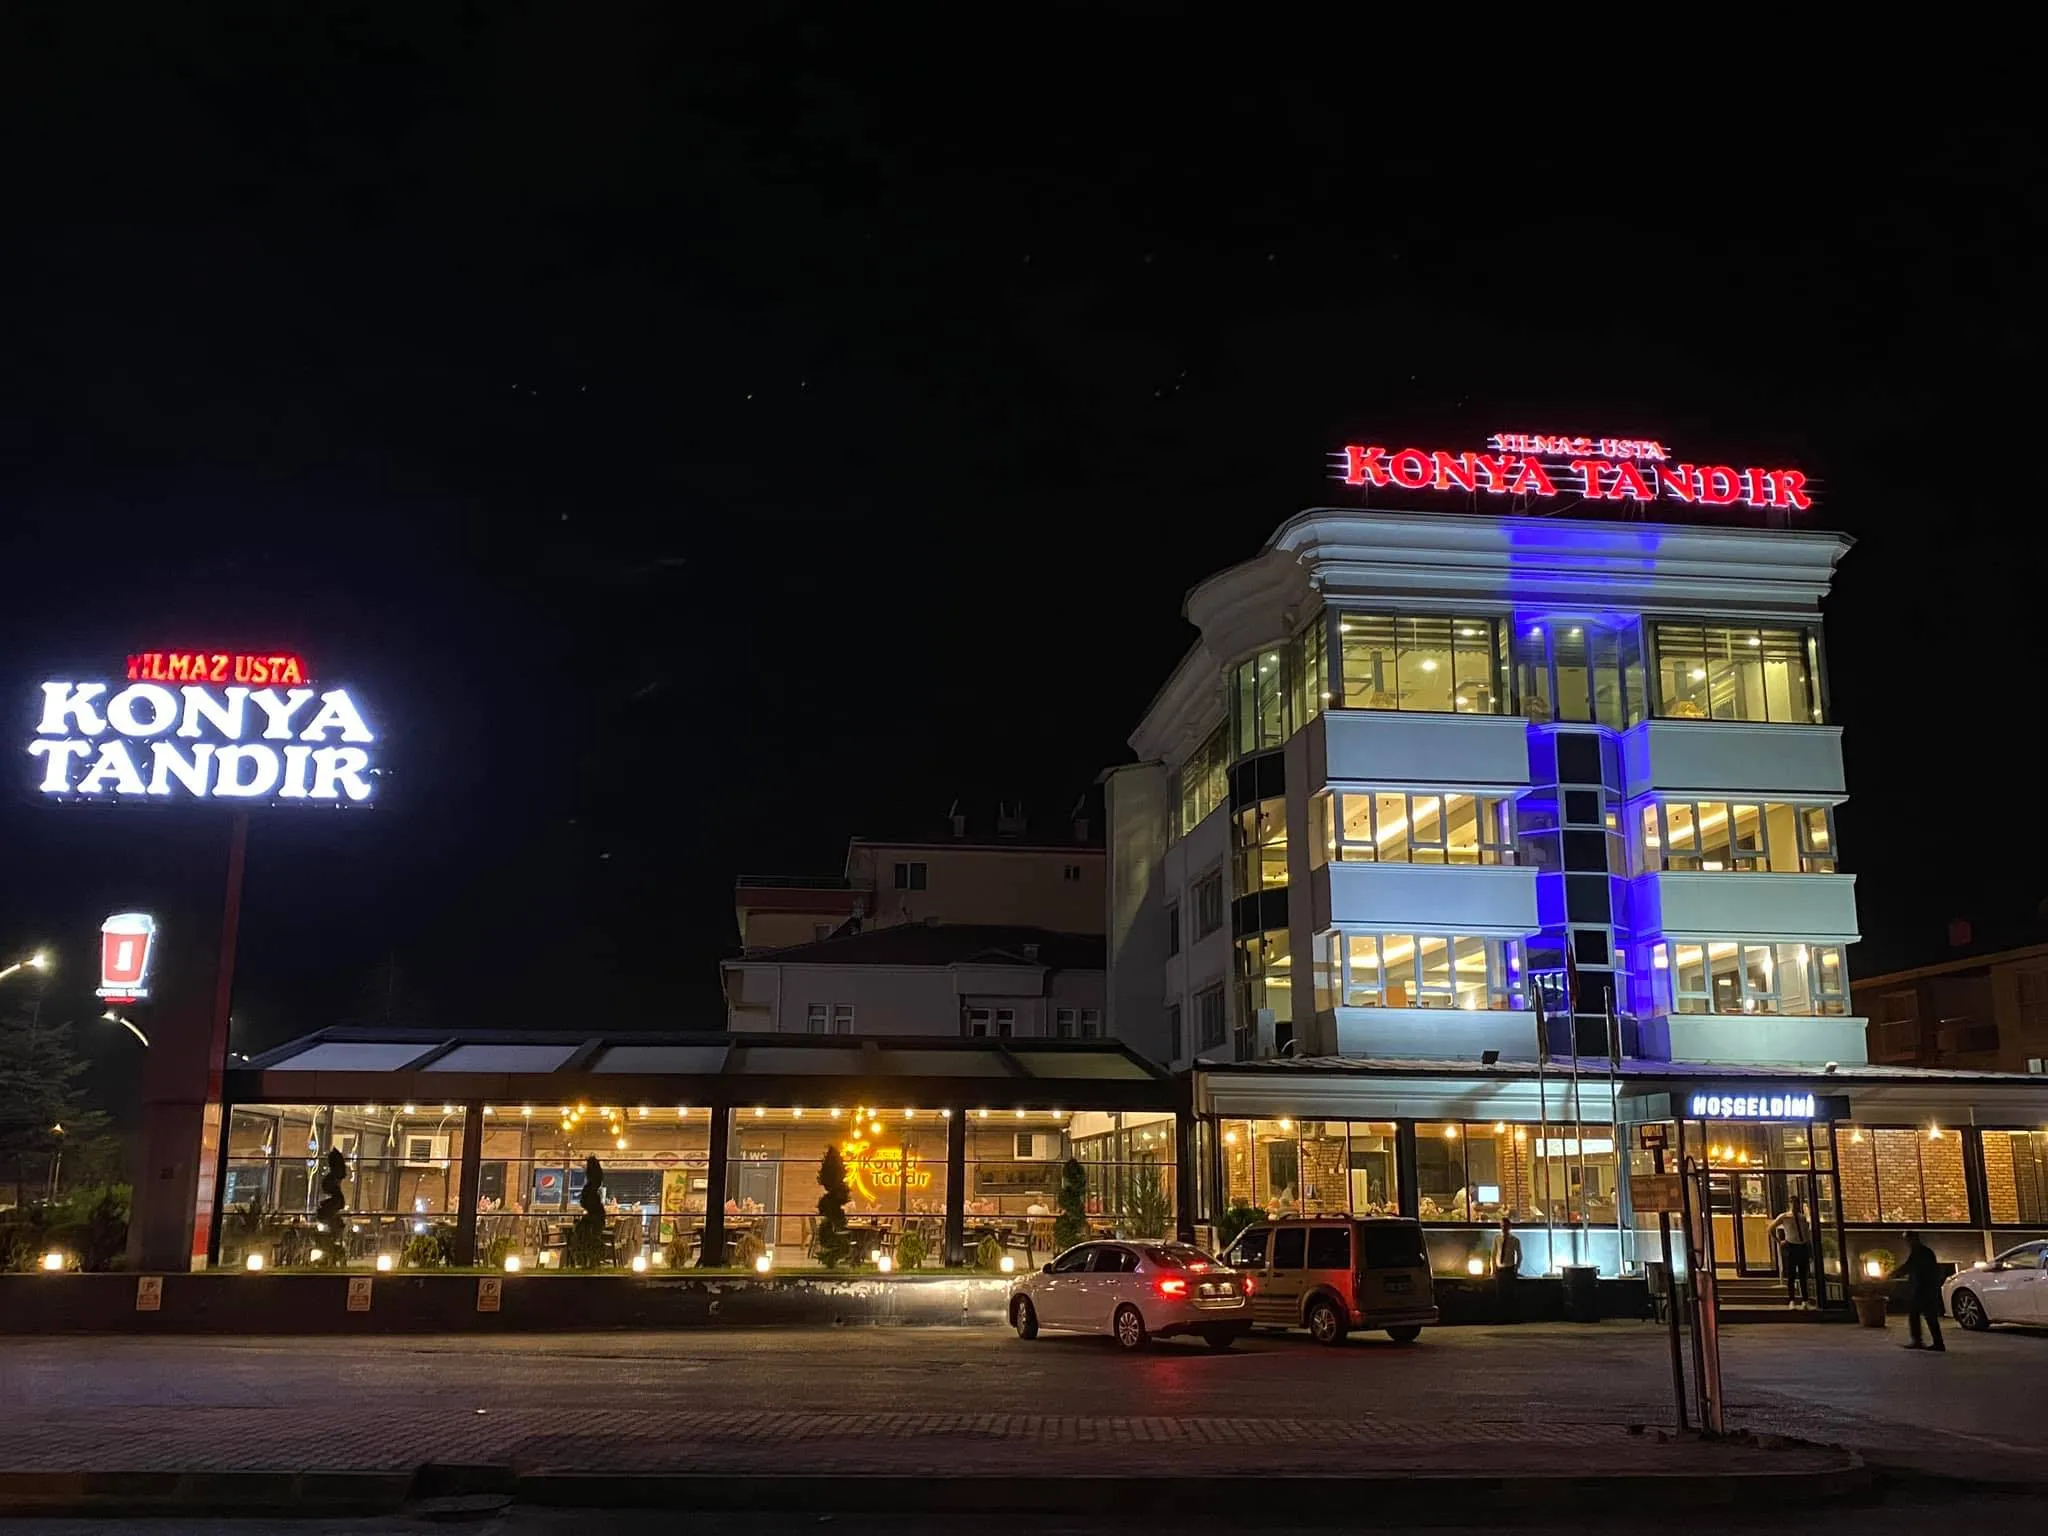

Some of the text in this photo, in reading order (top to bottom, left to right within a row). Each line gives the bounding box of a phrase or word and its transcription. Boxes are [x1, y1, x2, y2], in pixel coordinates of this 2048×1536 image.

[1495, 433, 1666, 461] YILMAZ USTA
[1345, 446, 1812, 509] KONYA TANDIR
[127, 653, 301, 684] YILMAZ USTA
[36, 681, 374, 742] KONYA
[28, 738, 372, 800] TANDIR
[749, 1151, 768, 1160] WC
